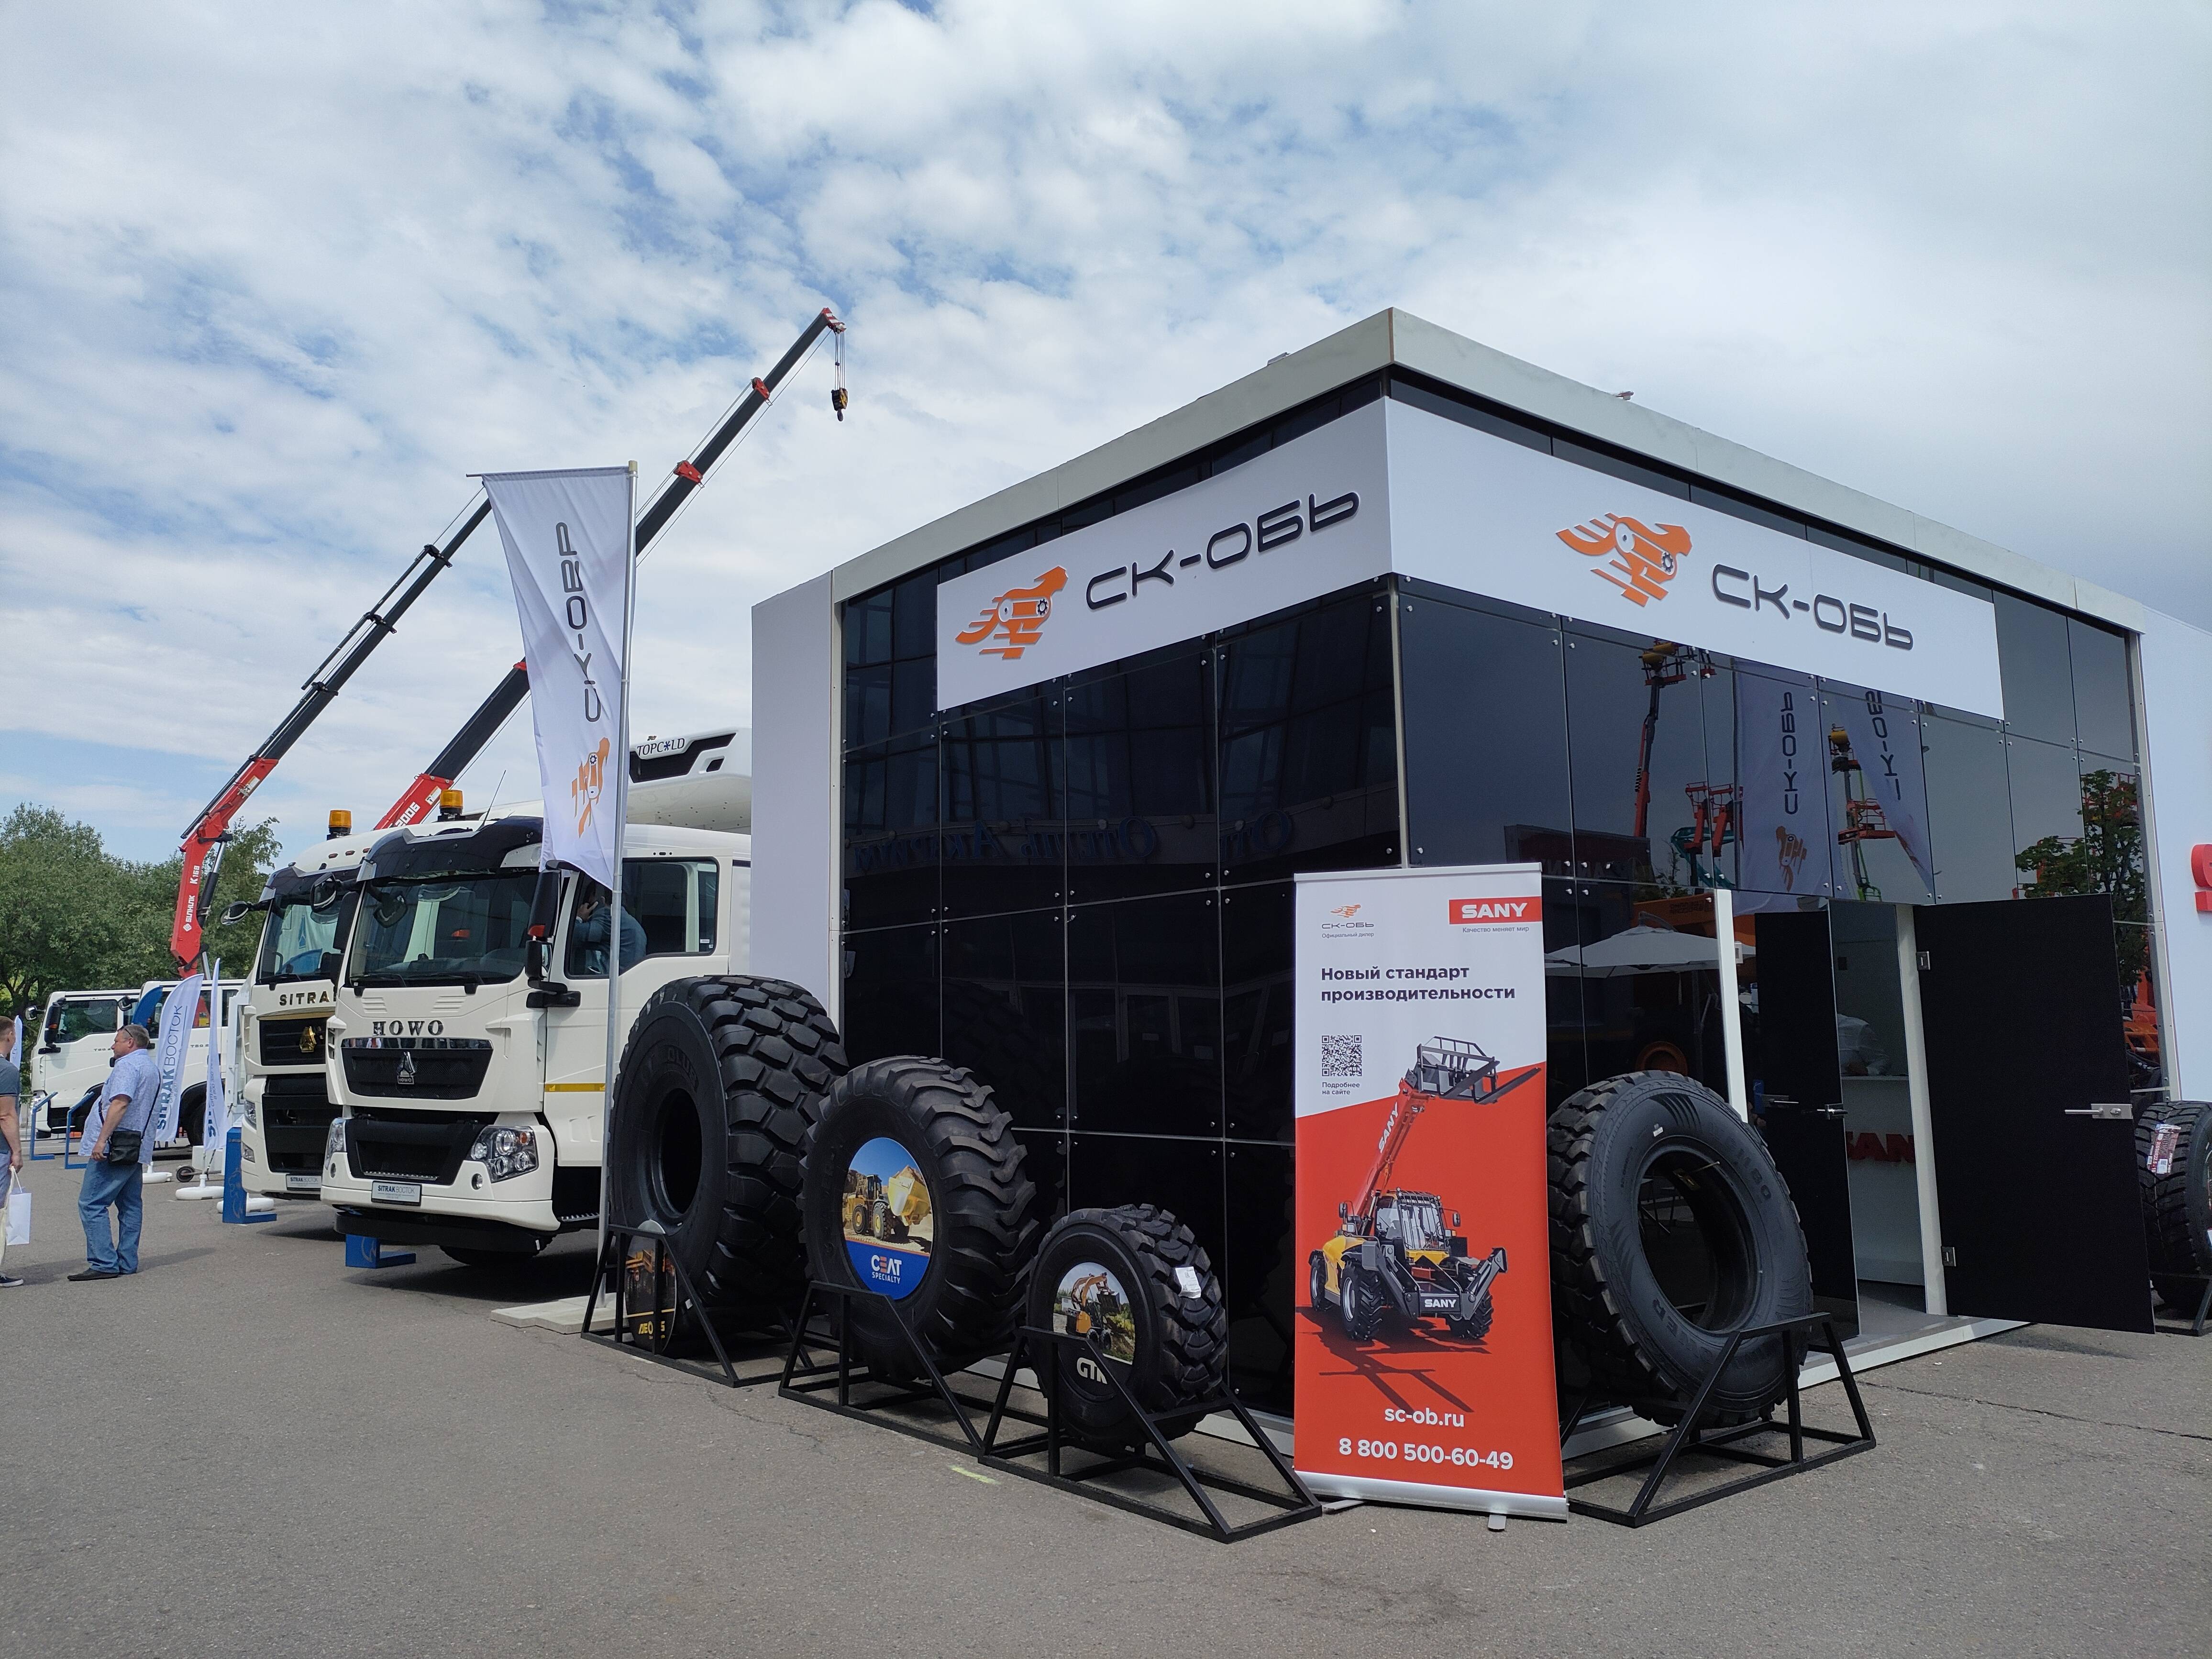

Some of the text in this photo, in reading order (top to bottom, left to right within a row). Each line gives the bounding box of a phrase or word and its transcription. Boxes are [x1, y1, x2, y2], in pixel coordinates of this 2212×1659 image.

[1085, 491, 1360, 610] СК-ОБЬ
[1712, 564, 1914, 651] СК-ОБЬ
[1461, 903, 1527, 918] SANY
[1321, 966, 1470, 981] Новый стандарт
[1321, 988, 1515, 1003] производительности
[372, 1020, 444, 1036] HOWO
[1379, 1102, 1398, 1154] SANY
[871, 1255, 902, 1276] CEAT
[872, 1271, 901, 1284] SPECIALTY
[1425, 1299, 1457, 1307] SANY
[638, 1321, 665, 1335] AEOS
[1385, 1408, 1464, 1427] sc-ob.ru
[1339, 1438, 1514, 1470] 8 800 500-60-49
